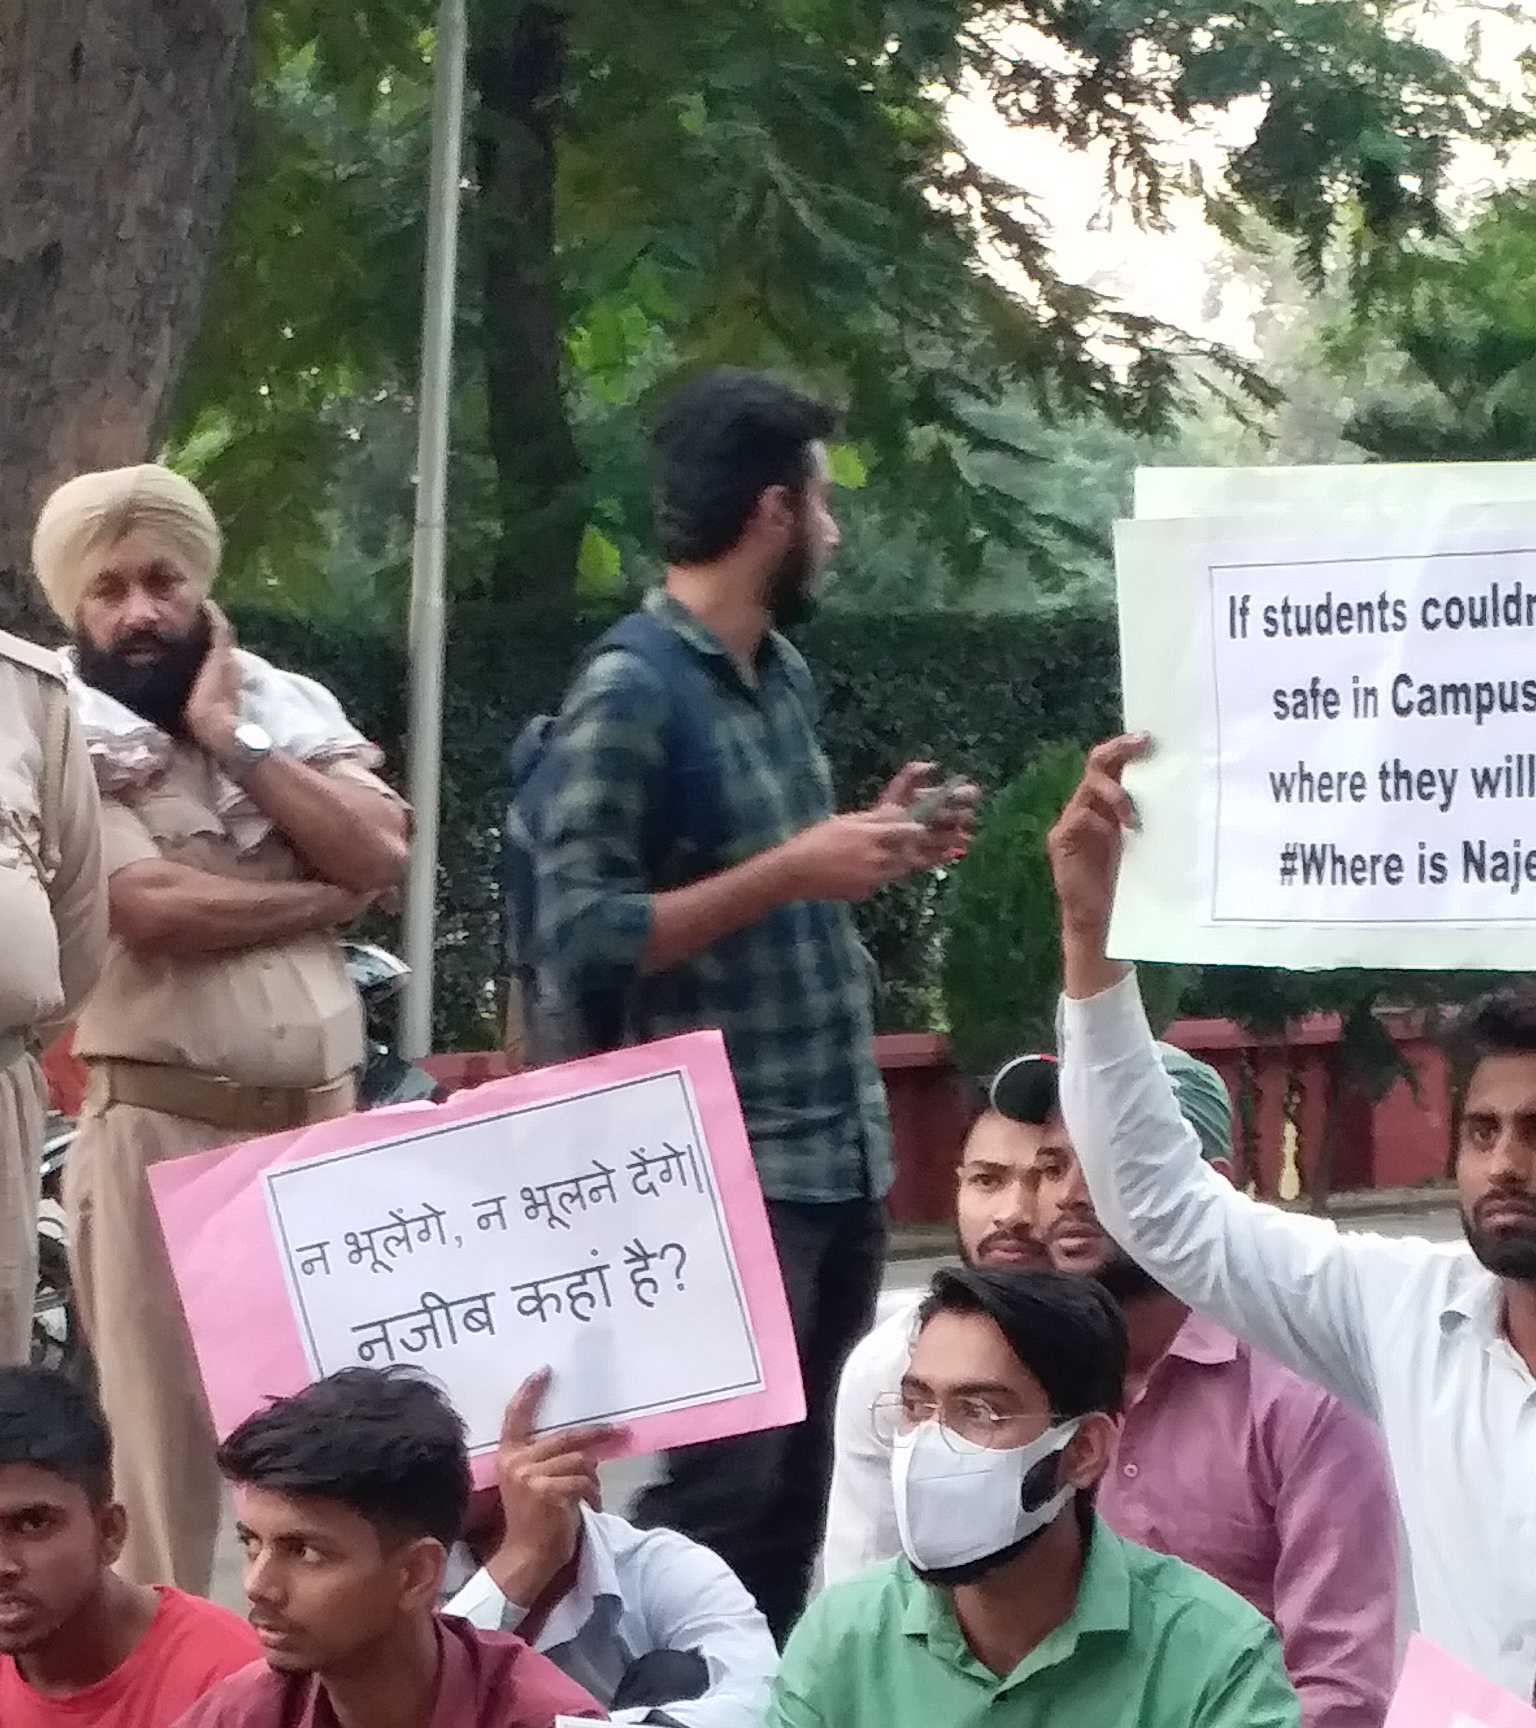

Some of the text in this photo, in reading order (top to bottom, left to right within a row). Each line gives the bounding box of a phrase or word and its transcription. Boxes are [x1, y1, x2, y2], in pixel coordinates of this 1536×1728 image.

[1228, 593, 1251, 640] If
[1263, 590, 1408, 638] students
[1272, 676, 1340, 721] safe
[1352, 675, 1379, 718] in
[1269, 761, 1366, 804] where
[1378, 759, 1457, 812] they
[1471, 754, 1536, 799] will
[1278, 842, 1402, 887] #Where
[1417, 840, 1447, 885] is
[296, 1240, 330, 1277] न
[343, 1202, 463, 1274] भूलेंगे,
[473, 1195, 506, 1233] न
[520, 1159, 618, 1230] भूलने
[352, 1238, 687, 1363] नजीब कहां है?
